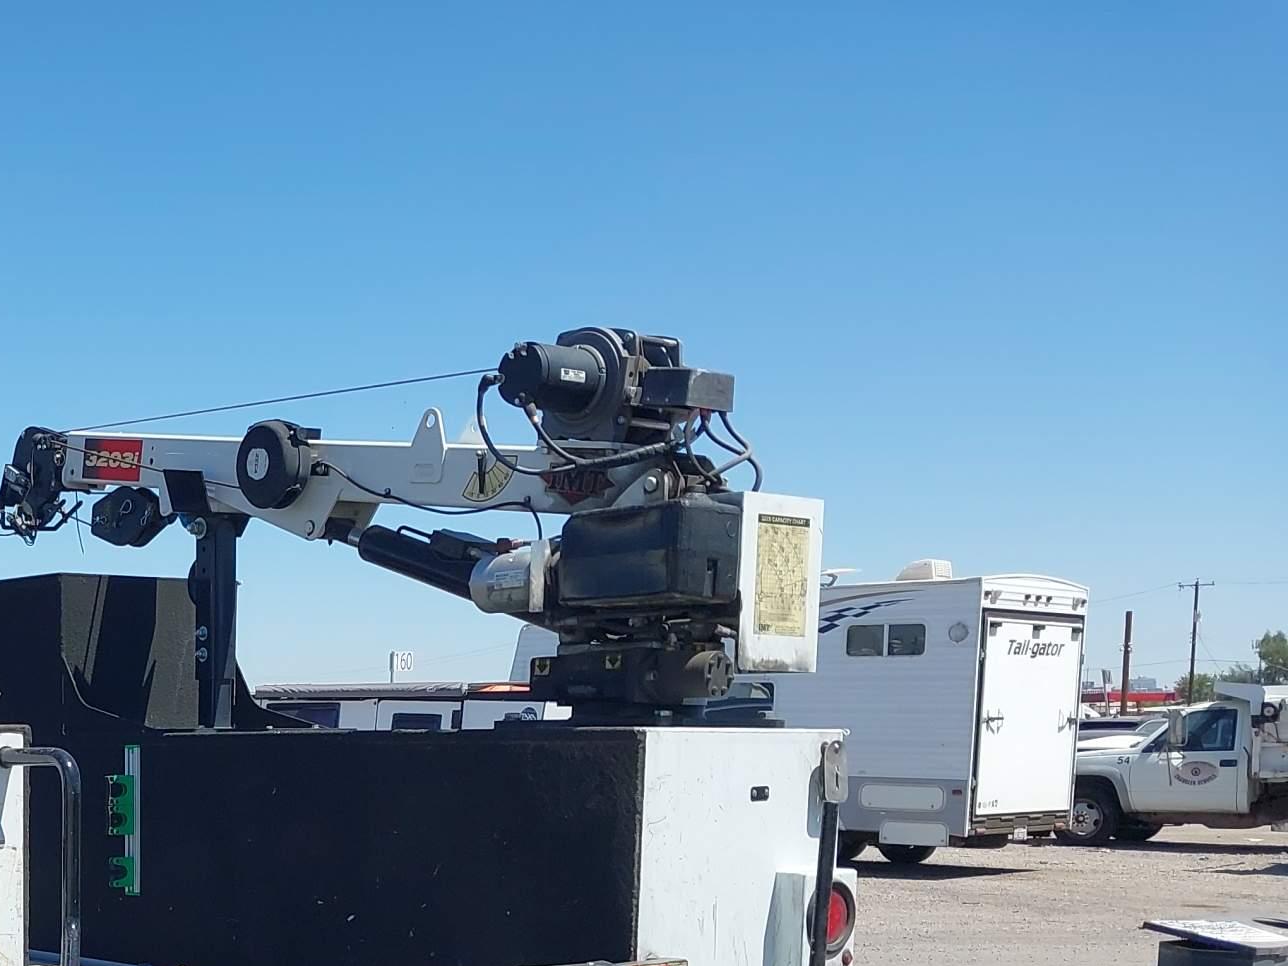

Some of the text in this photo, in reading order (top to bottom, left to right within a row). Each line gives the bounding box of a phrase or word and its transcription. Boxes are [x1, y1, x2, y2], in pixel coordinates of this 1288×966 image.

[85, 450, 140, 469] 3203i
[395, 652, 412, 670] 160
[1117, 756, 1130, 765] 54
